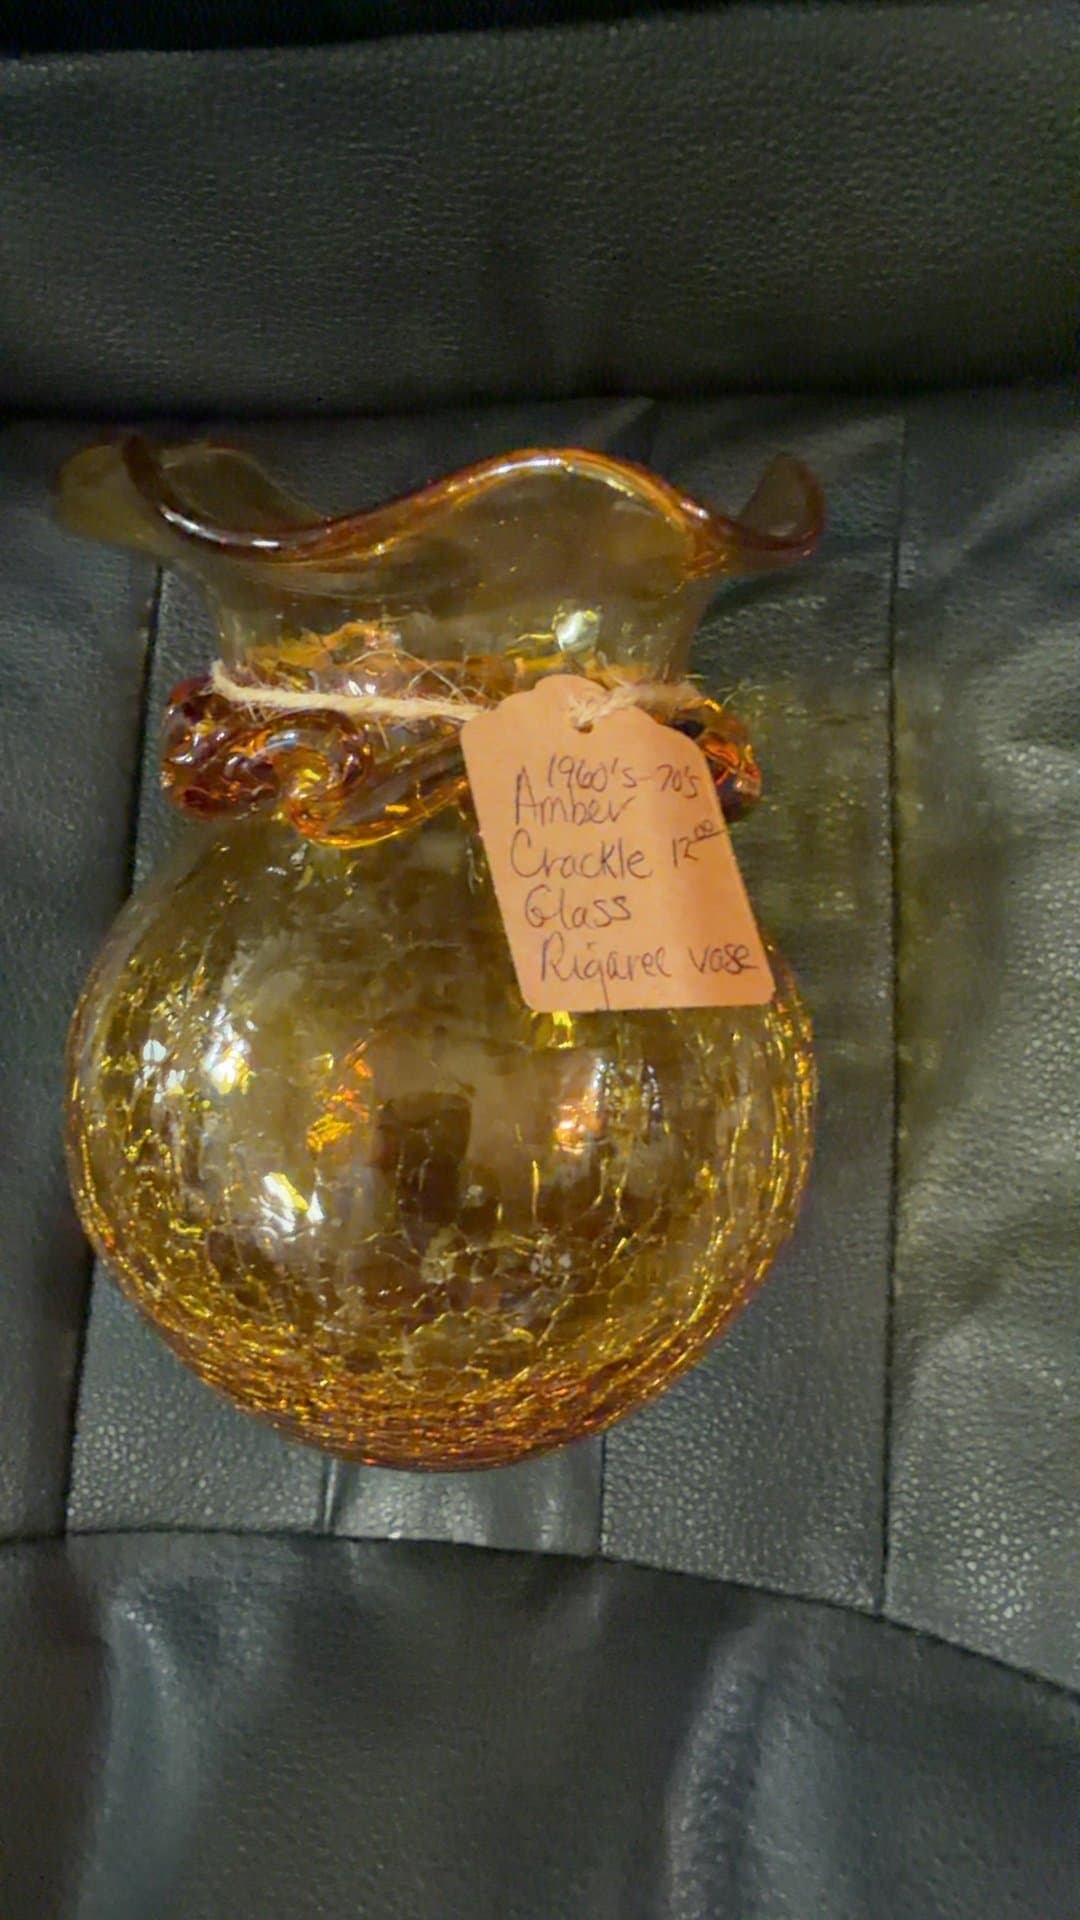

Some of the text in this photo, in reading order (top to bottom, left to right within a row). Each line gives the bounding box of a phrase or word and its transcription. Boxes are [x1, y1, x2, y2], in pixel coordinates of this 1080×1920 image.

[514, 765, 635, 826] Amber
[510, 829, 653, 880] Crackle
[524, 884, 632, 929] Glass
